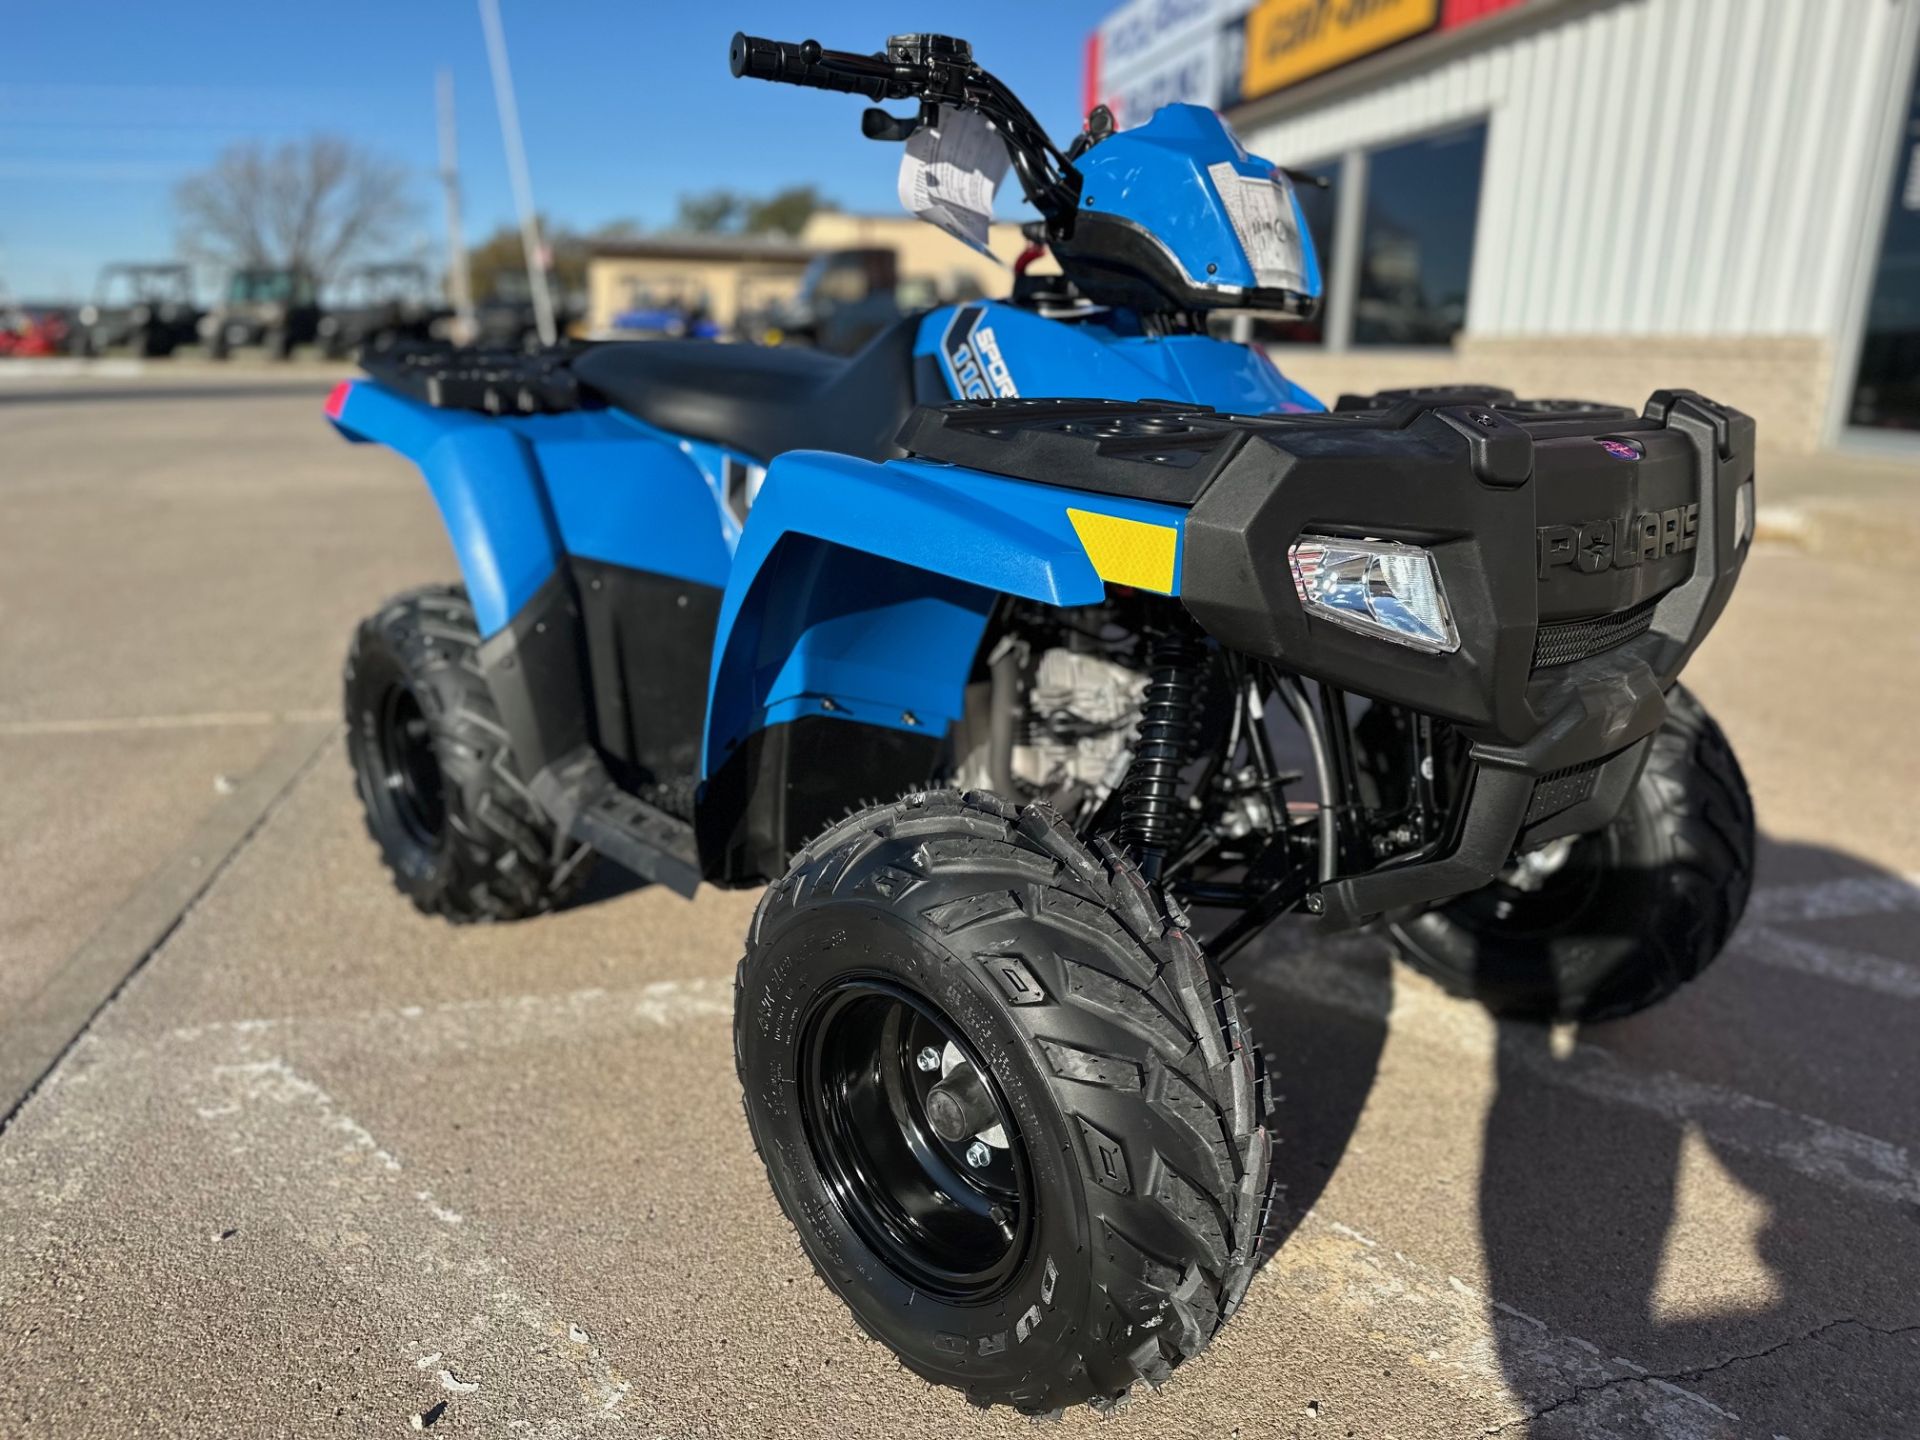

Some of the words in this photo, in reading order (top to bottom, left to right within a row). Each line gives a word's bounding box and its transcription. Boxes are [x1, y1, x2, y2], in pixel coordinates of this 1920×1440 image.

[975, 327, 1020, 399] SPOR
[1537, 503, 1699, 580] POLARIS
[932, 1254, 1060, 1357] DURO
